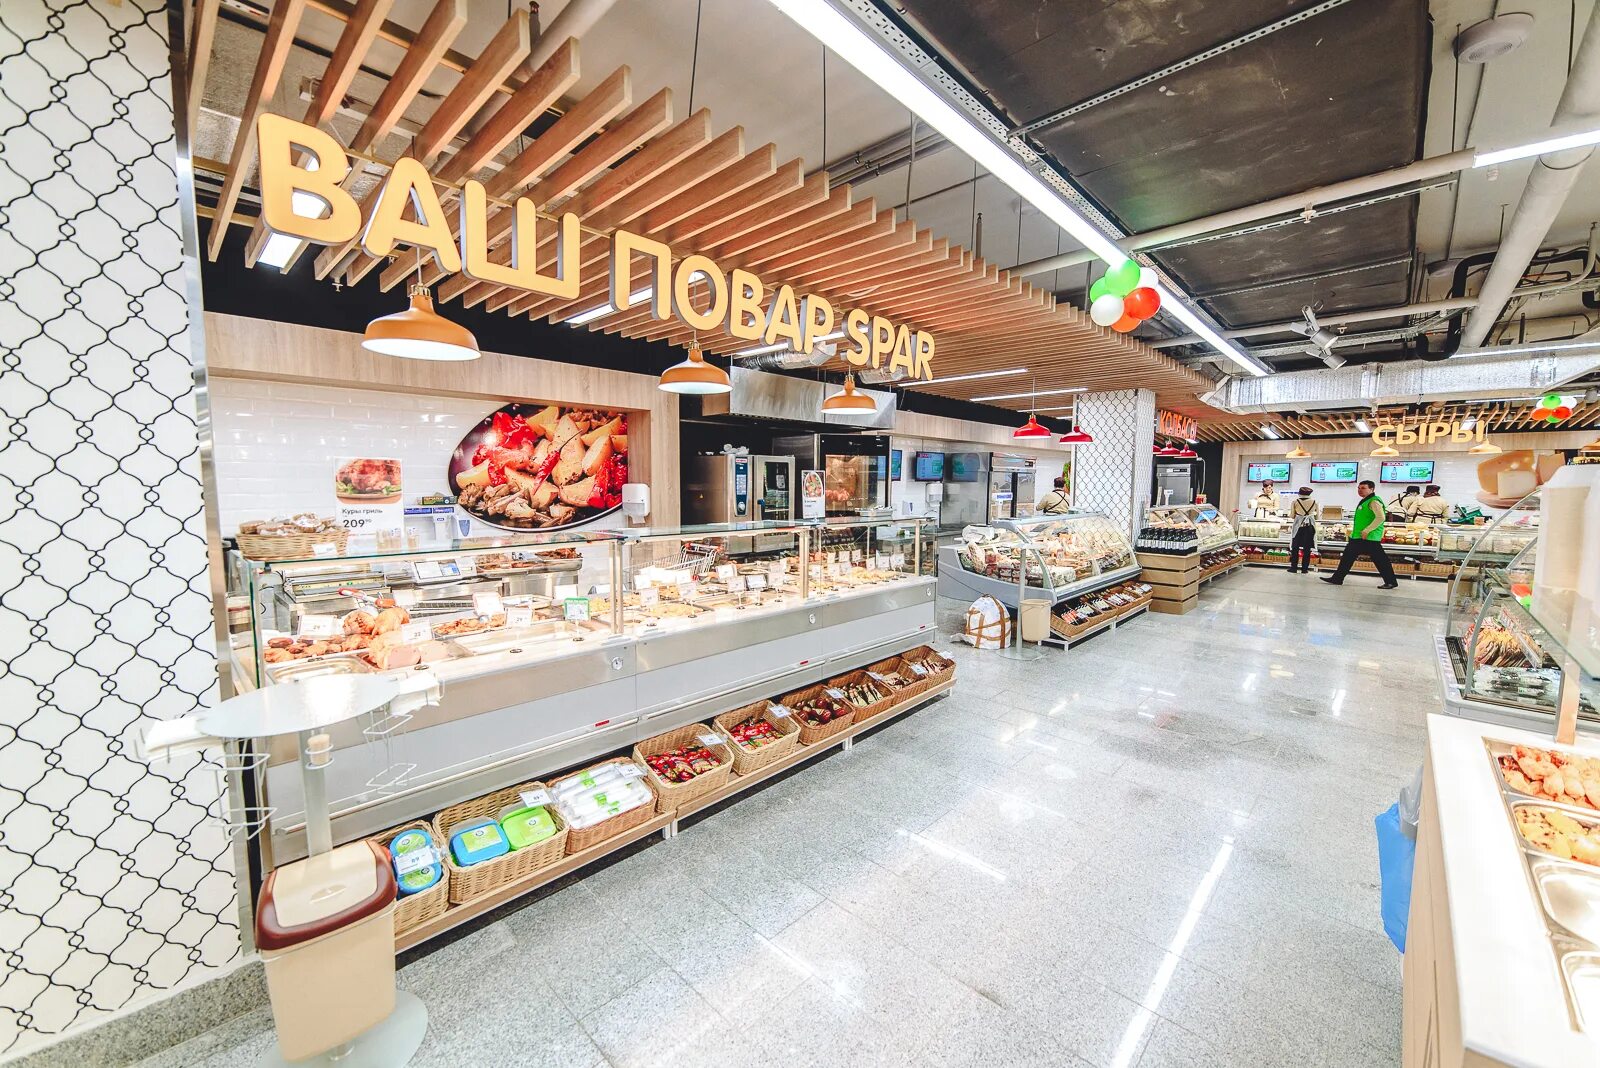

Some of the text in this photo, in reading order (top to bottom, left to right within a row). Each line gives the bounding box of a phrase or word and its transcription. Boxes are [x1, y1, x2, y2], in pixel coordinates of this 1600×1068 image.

[257, 112, 935, 381] ВАШ ПОВАР SPAR
[1372, 420, 1485, 445] СЫРЫ
